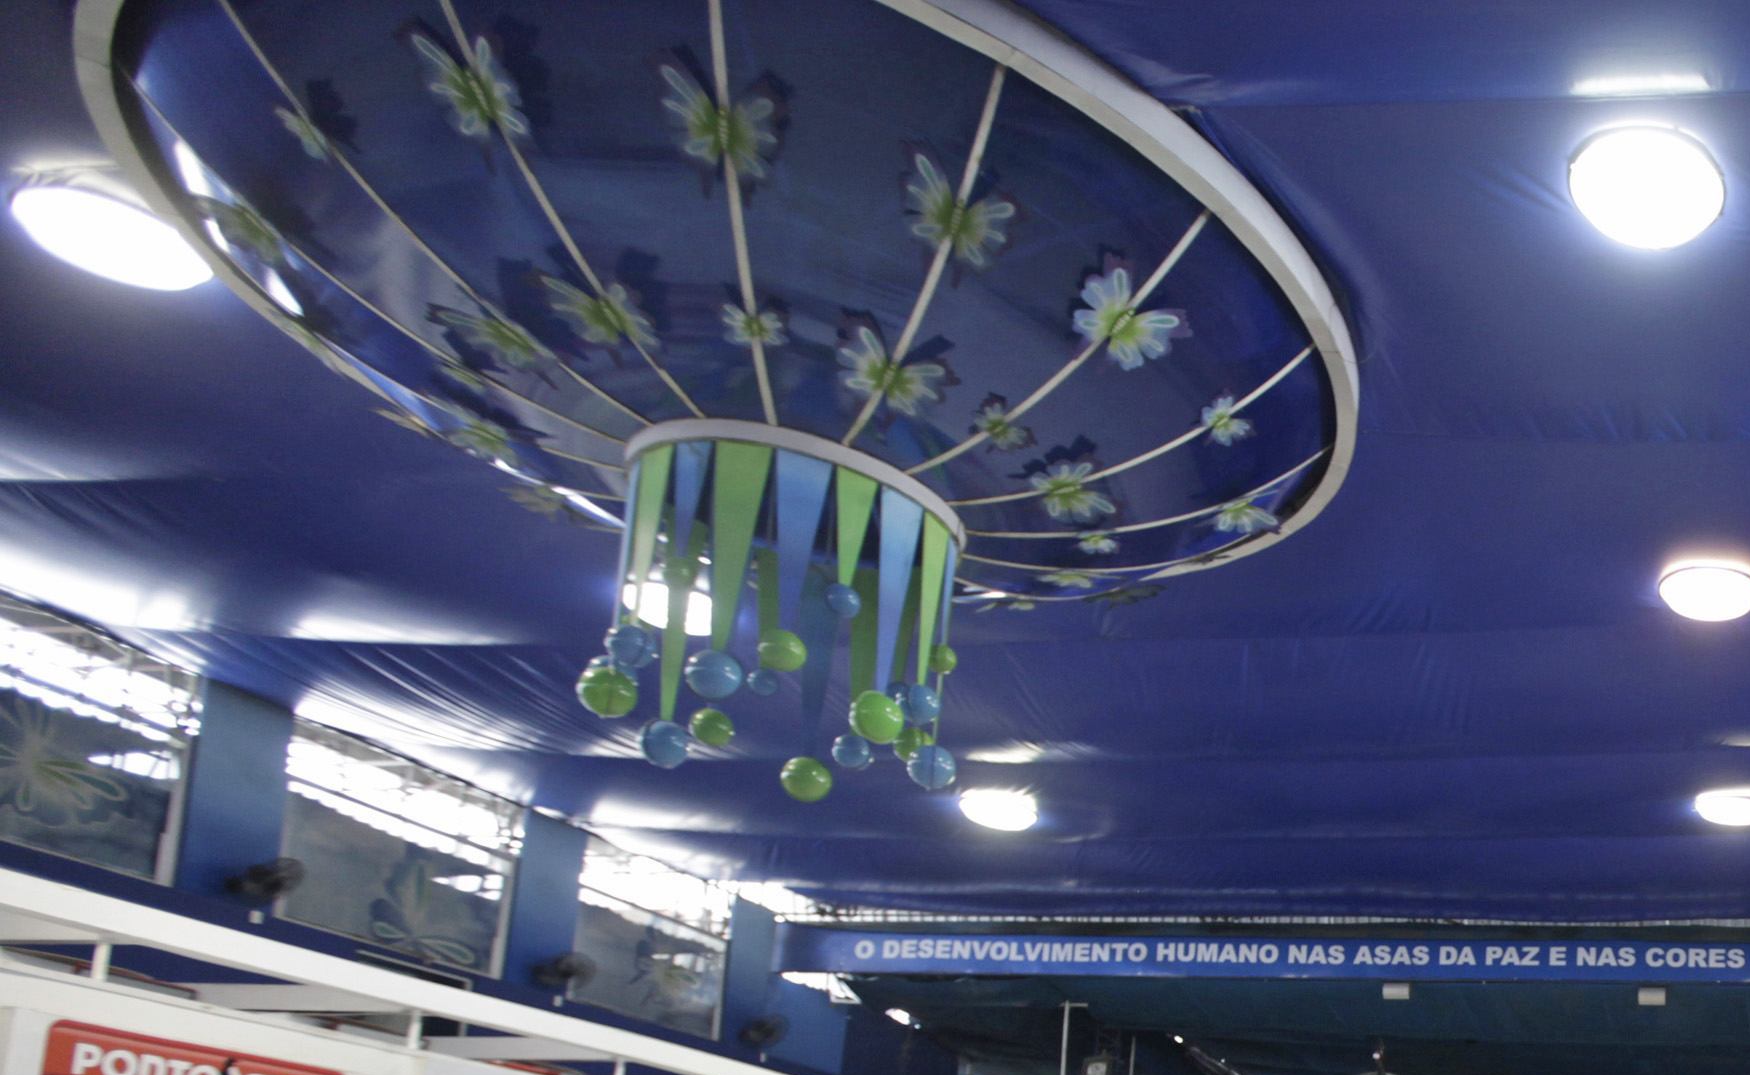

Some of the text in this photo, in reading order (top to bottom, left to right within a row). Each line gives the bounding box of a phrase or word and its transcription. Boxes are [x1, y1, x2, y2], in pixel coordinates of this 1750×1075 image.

[854, 939, 875, 960] O
[881, 939, 1148, 963] DESENVOLVIMENTO
[1155, 942, 1279, 965] HUMANO
[1287, 944, 1345, 965] NAS
[1353, 944, 1430, 966] ASAS
[1438, 946, 1477, 966] DA
[1484, 946, 1541, 967] PAZ
[1548, 946, 1567, 967] E
[1575, 946, 1637, 968] NAS
[1644, 947, 1746, 969] CORES
